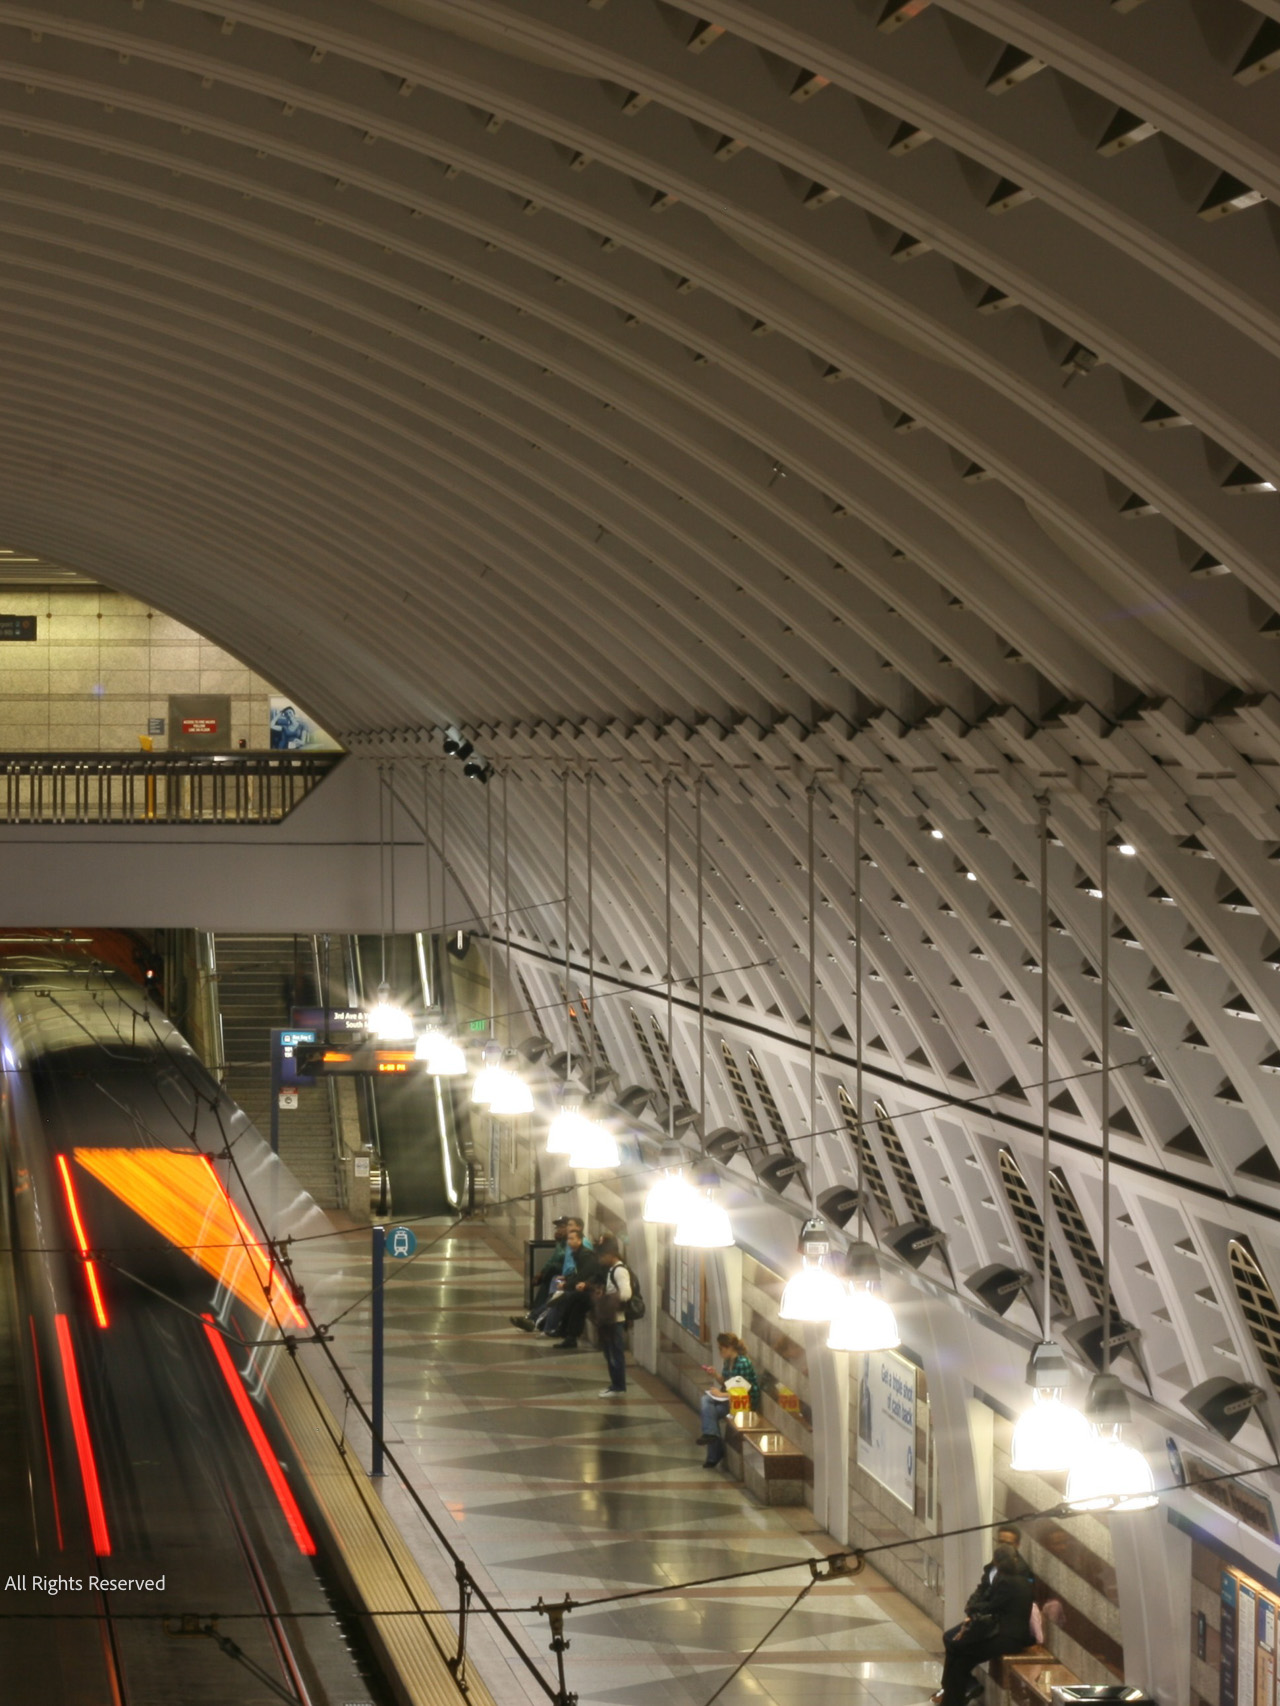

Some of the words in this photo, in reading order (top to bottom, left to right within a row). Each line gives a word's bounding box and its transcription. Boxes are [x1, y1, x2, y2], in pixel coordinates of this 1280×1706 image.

[334, 1012, 344, 1020] 3rd
[345, 1012, 357, 1020] Ave
[470, 1019, 488, 1031] EXIT
